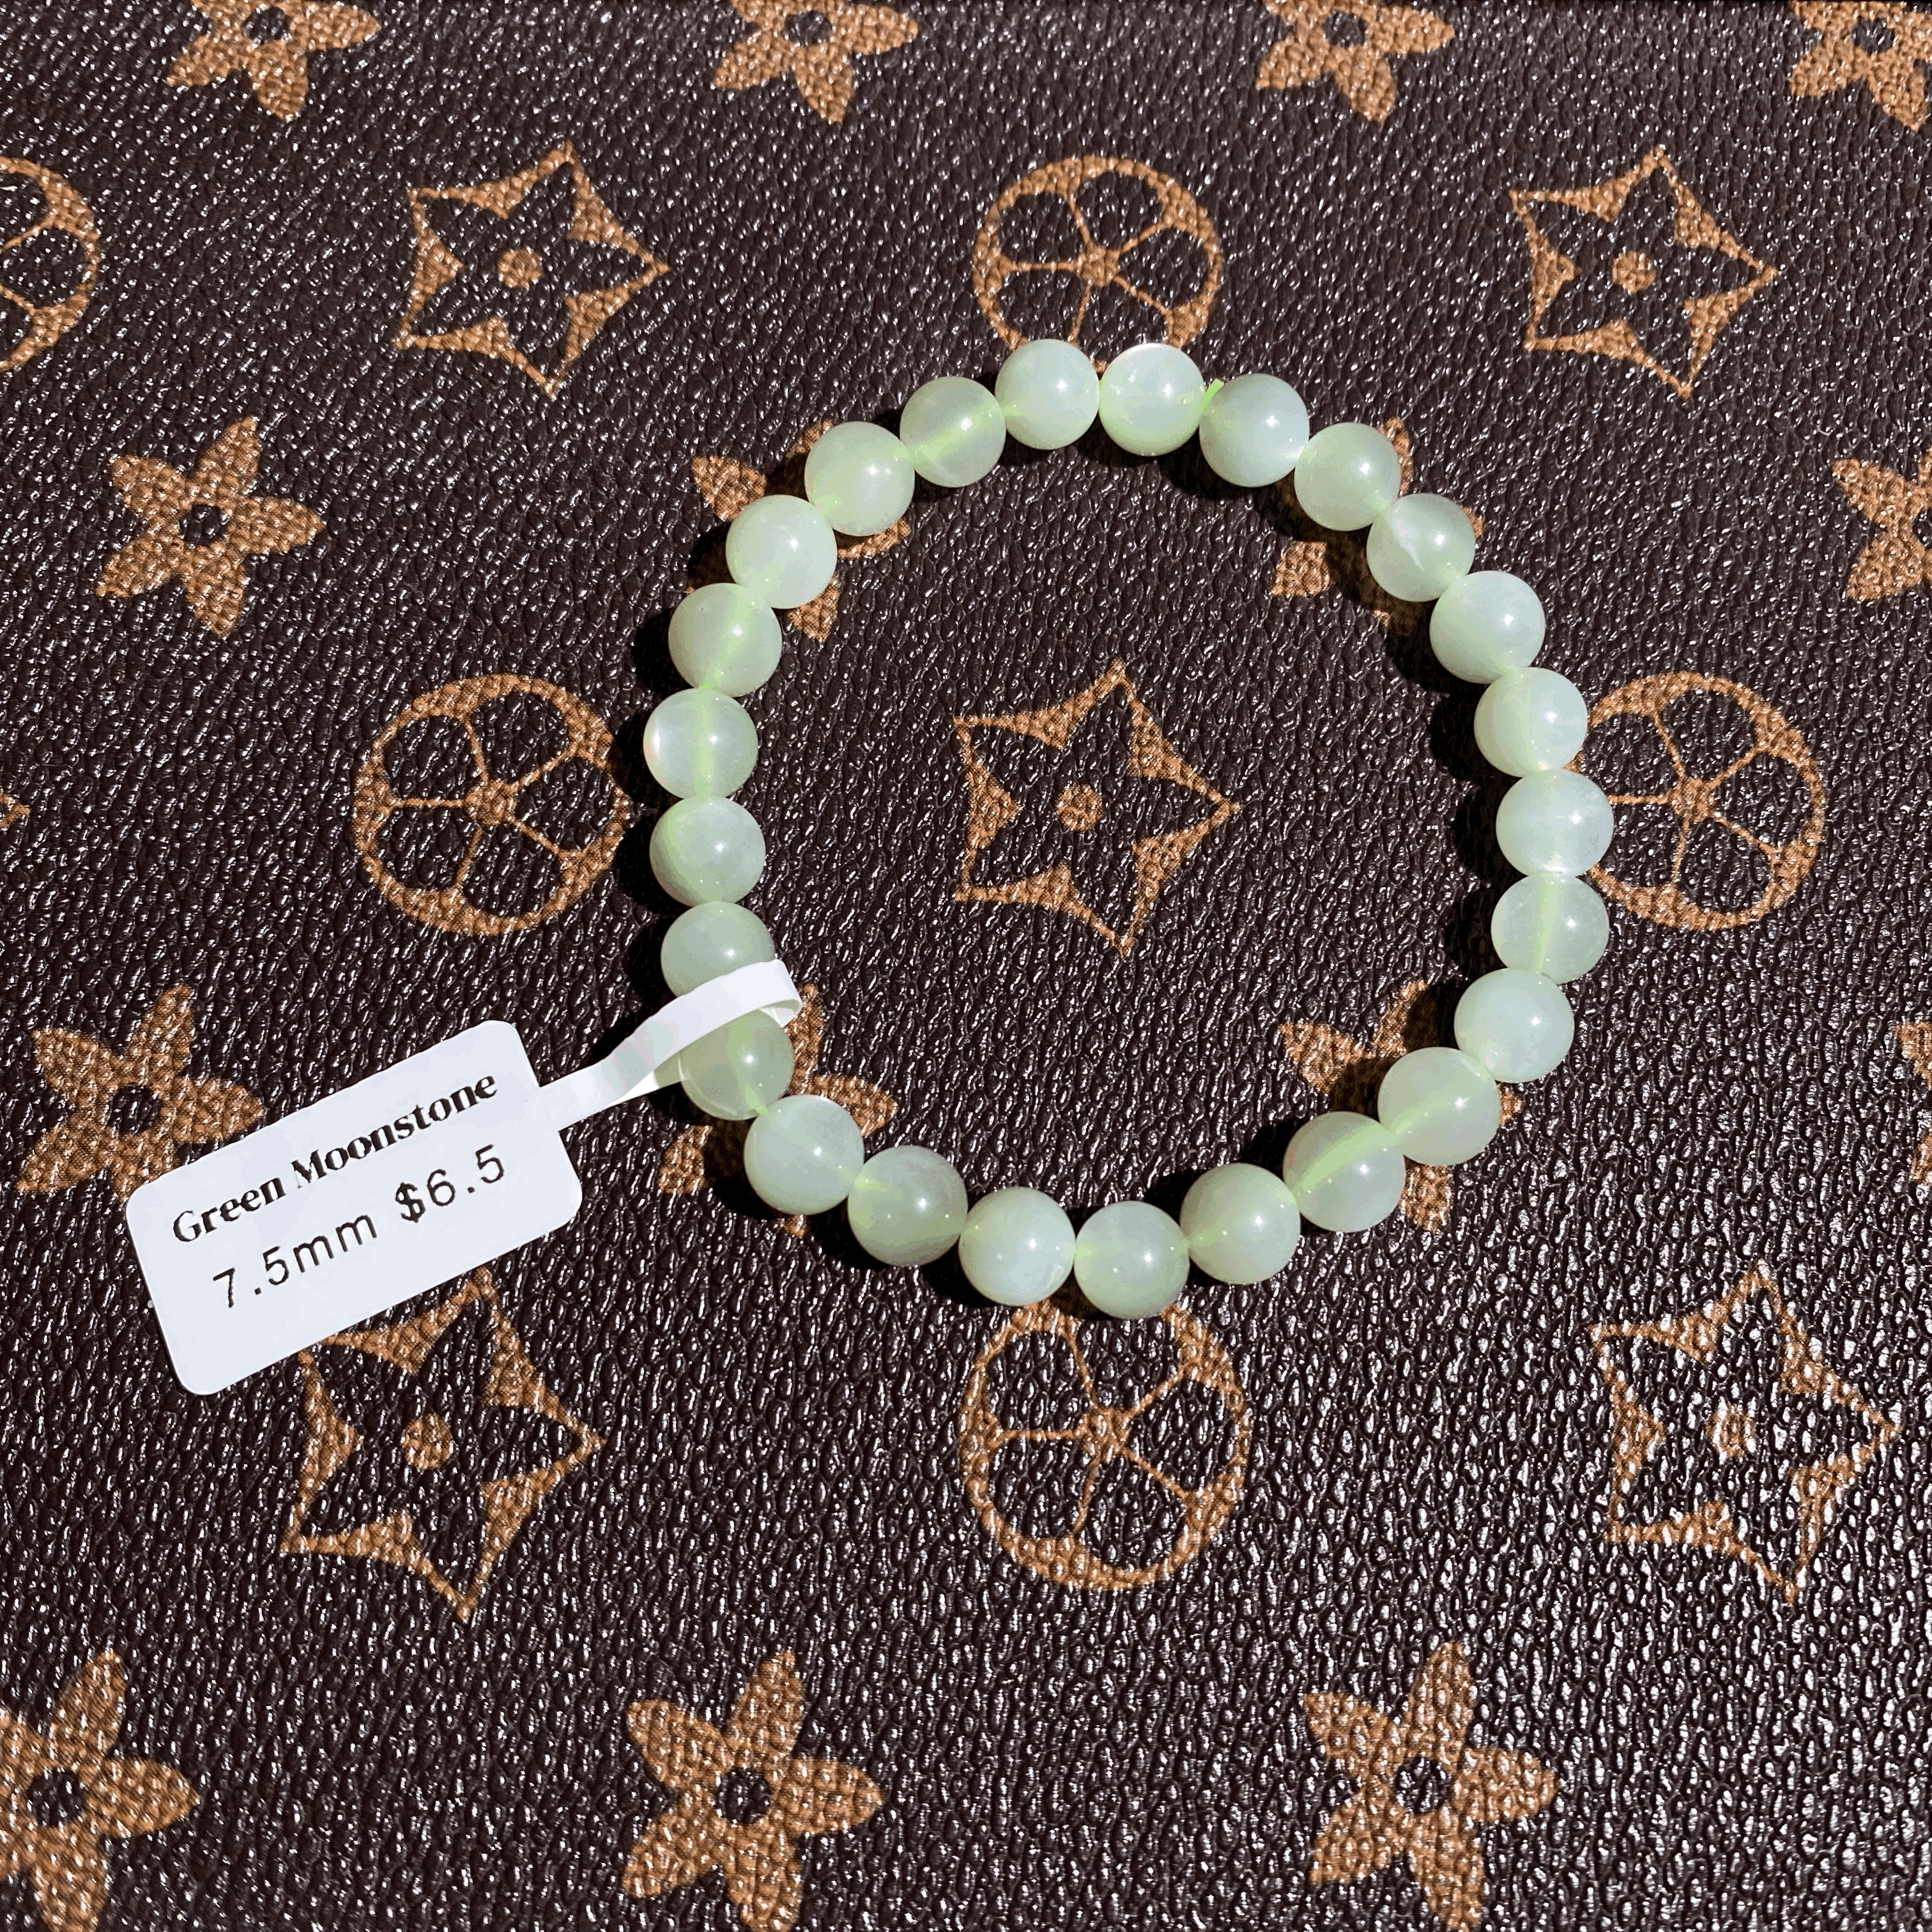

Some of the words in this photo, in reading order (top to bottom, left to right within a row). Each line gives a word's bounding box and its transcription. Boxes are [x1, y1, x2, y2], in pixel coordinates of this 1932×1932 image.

[172, 1177, 287, 1243] Green
[291, 1076, 497, 1189] Moonstone
[213, 1215, 378, 1308] 7.5mm
[395, 1144, 504, 1223] $6.5
